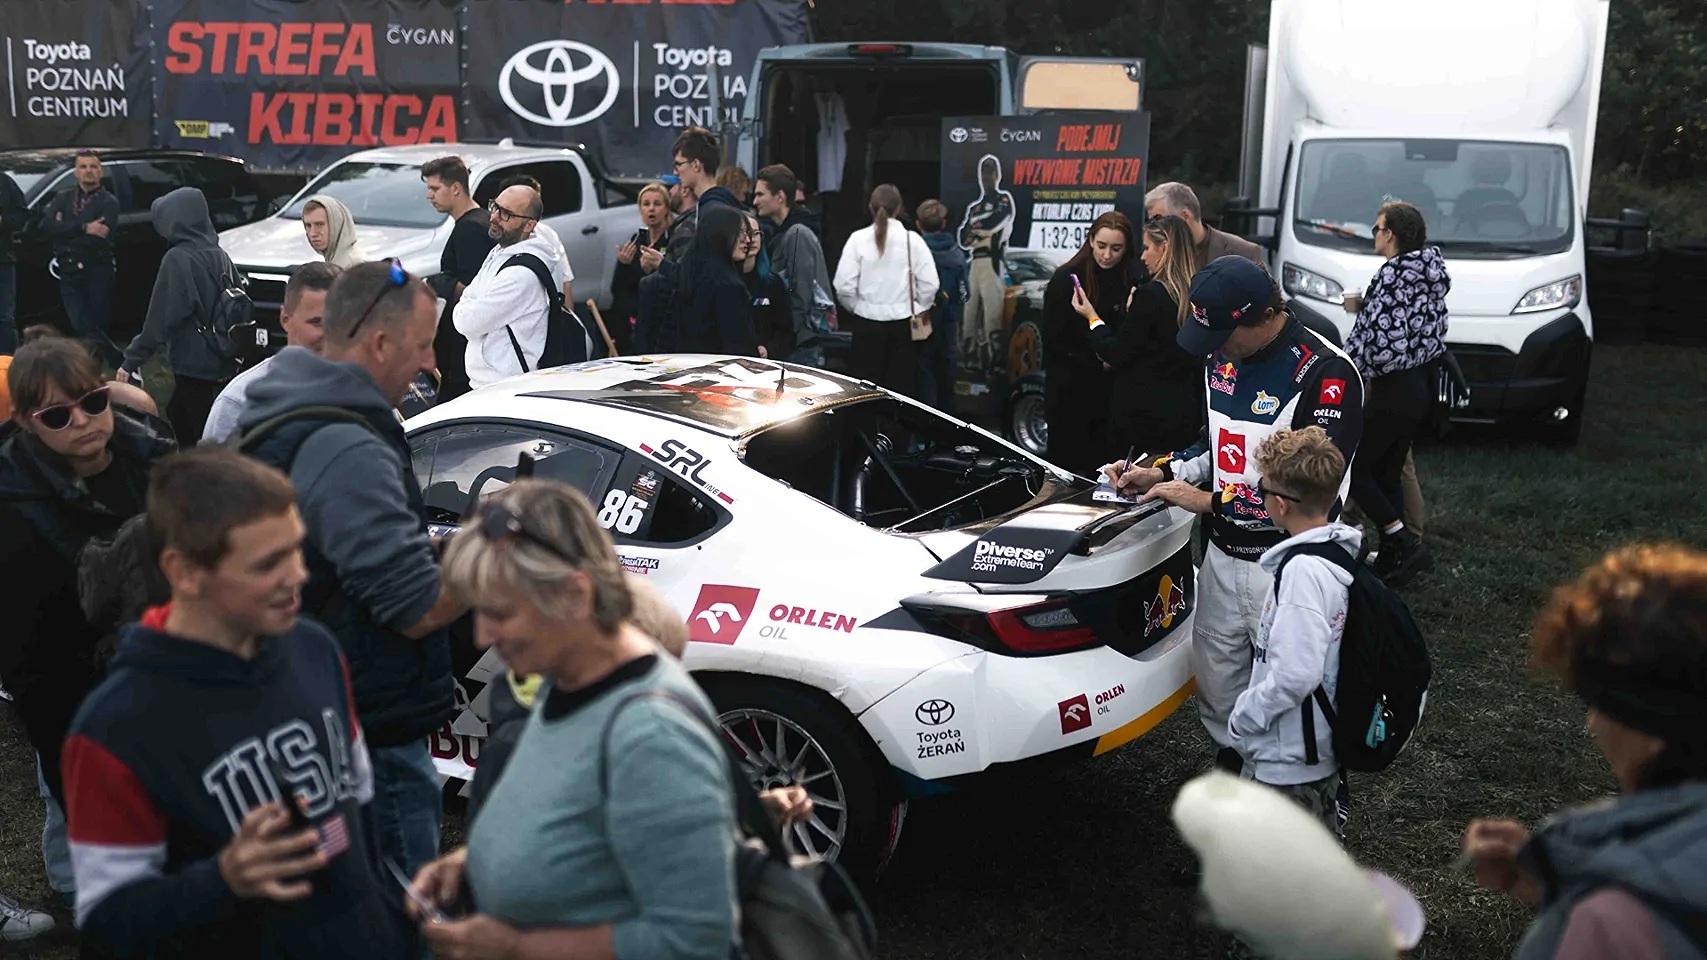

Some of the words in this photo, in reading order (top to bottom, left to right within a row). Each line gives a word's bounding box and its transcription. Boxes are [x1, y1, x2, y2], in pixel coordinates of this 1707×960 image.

[386, 27, 455, 45] CYGAN
[23, 39, 92, 65] Toyota
[165, 22, 376, 77] STREFA
[653, 43, 733, 71] Toyota
[26, 63, 125, 91] POZNAŃ
[654, 74, 748, 99] POZA
[28, 96, 128, 118] CENTRUM
[247, 93, 458, 146] KIBICA
[1000, 130, 1041, 142] CYGAN
[1056, 124, 1121, 151] PODEJMIJ
[1013, 159, 1082, 185] WYZWANIE
[1082, 158, 1141, 185] MISTRZA
[1071, 203, 1093, 220] CZAS
[1313, 408, 1342, 419] ORLEN
[1317, 417, 1329, 425] OIL
[596, 489, 649, 535] 86
[971, 562, 997, 572] .com
[973, 553, 1044, 571] ExtremeTeam
[769, 603, 857, 634] ORLEN
[759, 625, 788, 640] OIL
[1095, 683, 1125, 705] ORLEN
[1097, 705, 1111, 716] OIL
[916, 729, 961, 744] Toyota
[917, 738, 965, 759] ŻERAŃ
[202, 707, 352, 834] USA
